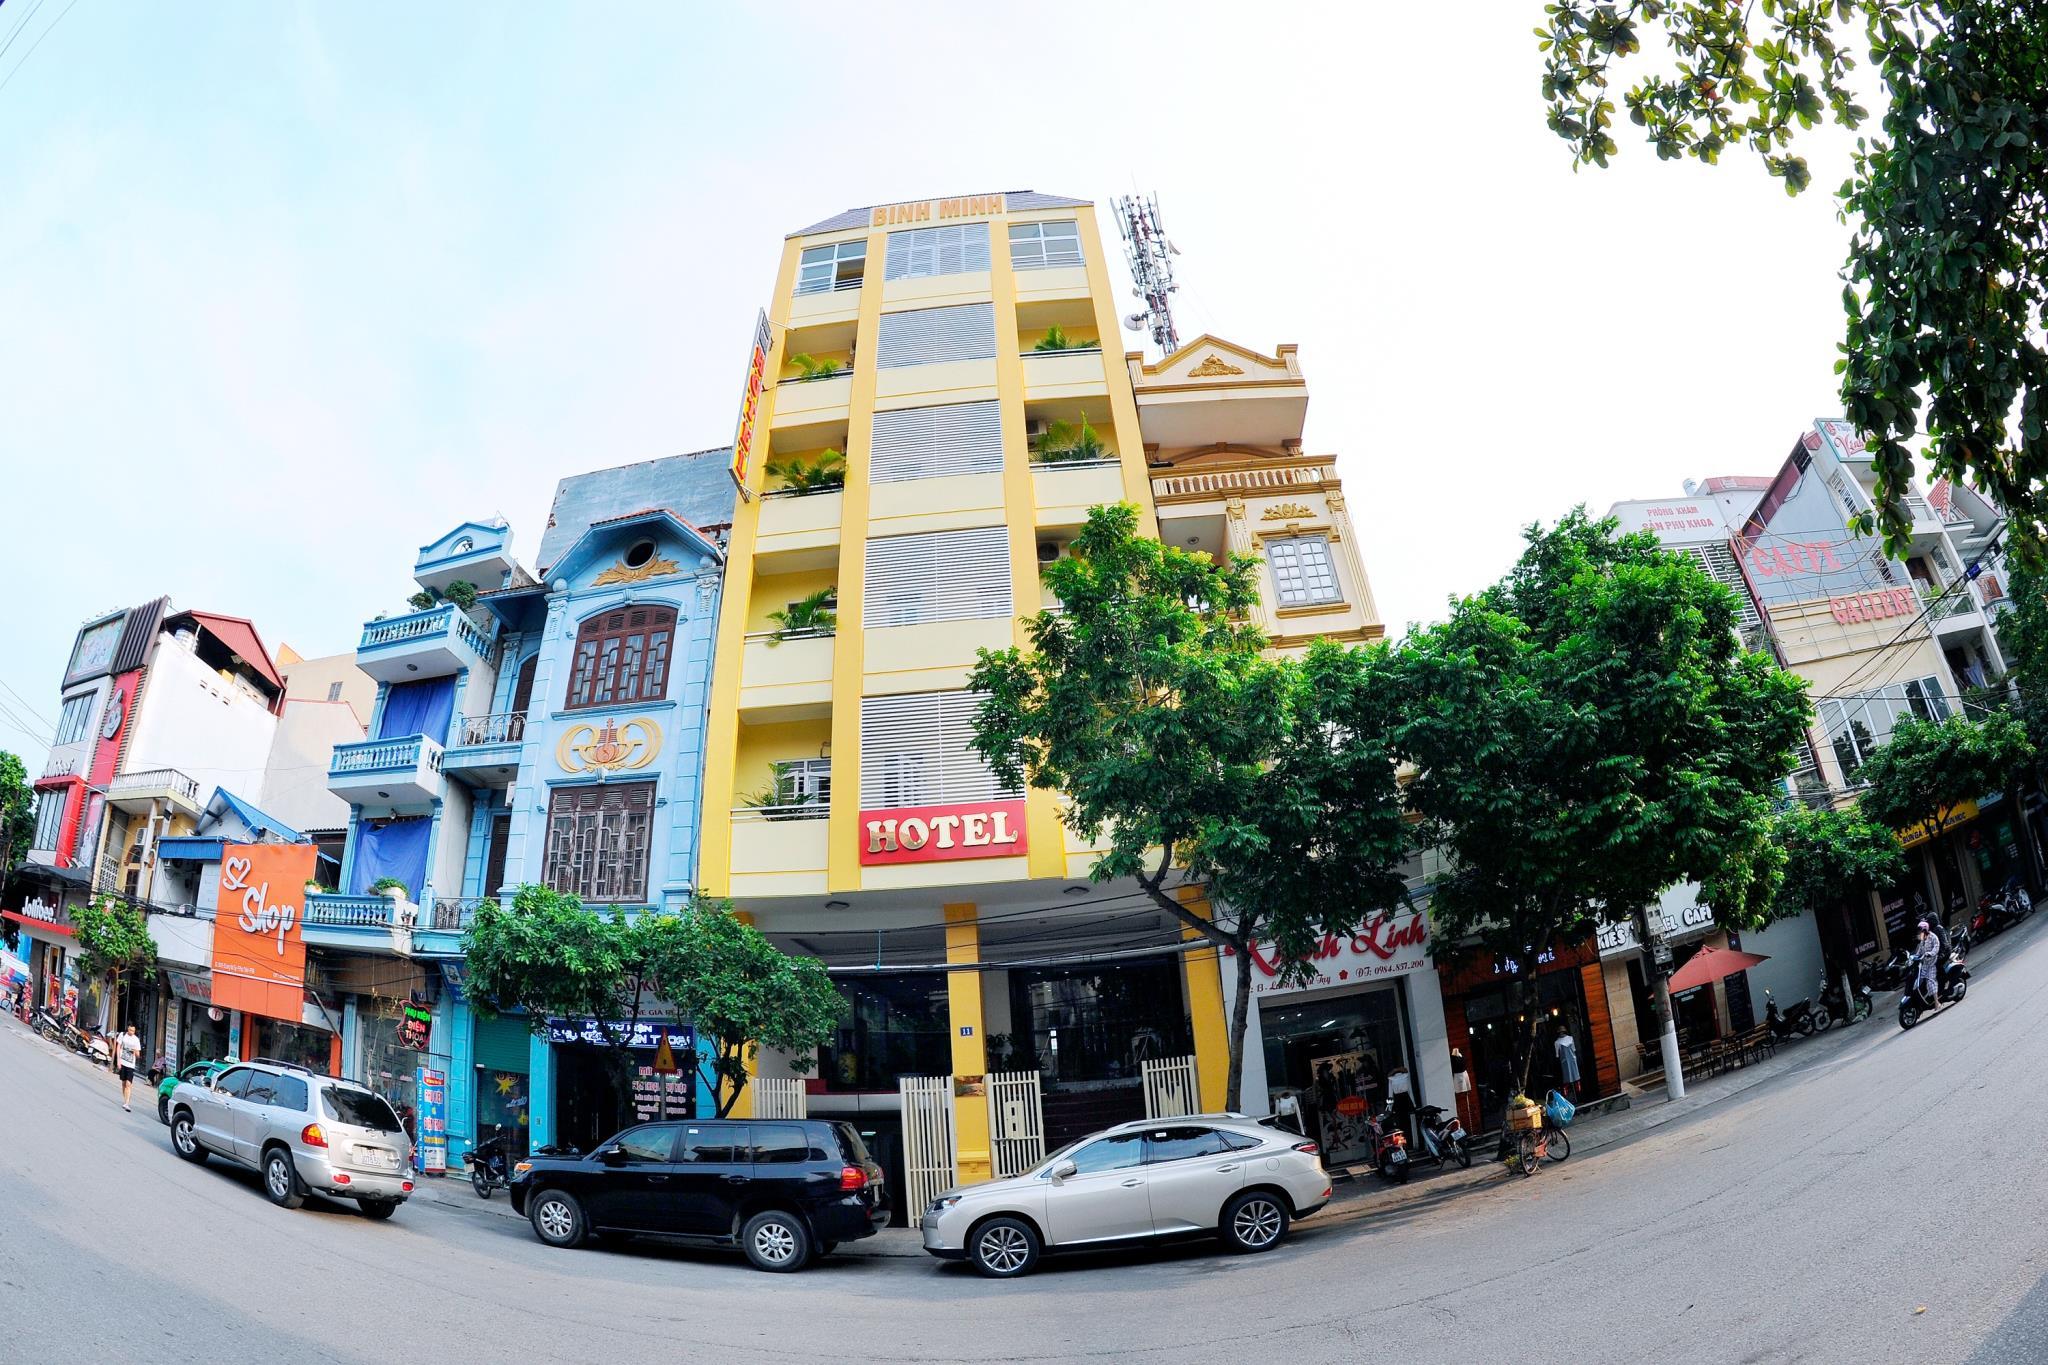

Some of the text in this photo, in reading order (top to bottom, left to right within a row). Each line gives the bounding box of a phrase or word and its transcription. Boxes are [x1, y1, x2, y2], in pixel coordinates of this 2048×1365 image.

[939, 195, 1003, 219] MINH
[735, 345, 765, 481] HOTEL
[1687, 518, 1714, 529] KHOA
[1830, 587, 1914, 625] GALLERY
[866, 811, 1018, 853] HOTEL
[238, 881, 295, 956] Shop
[1351, 912, 1428, 960] Linh
